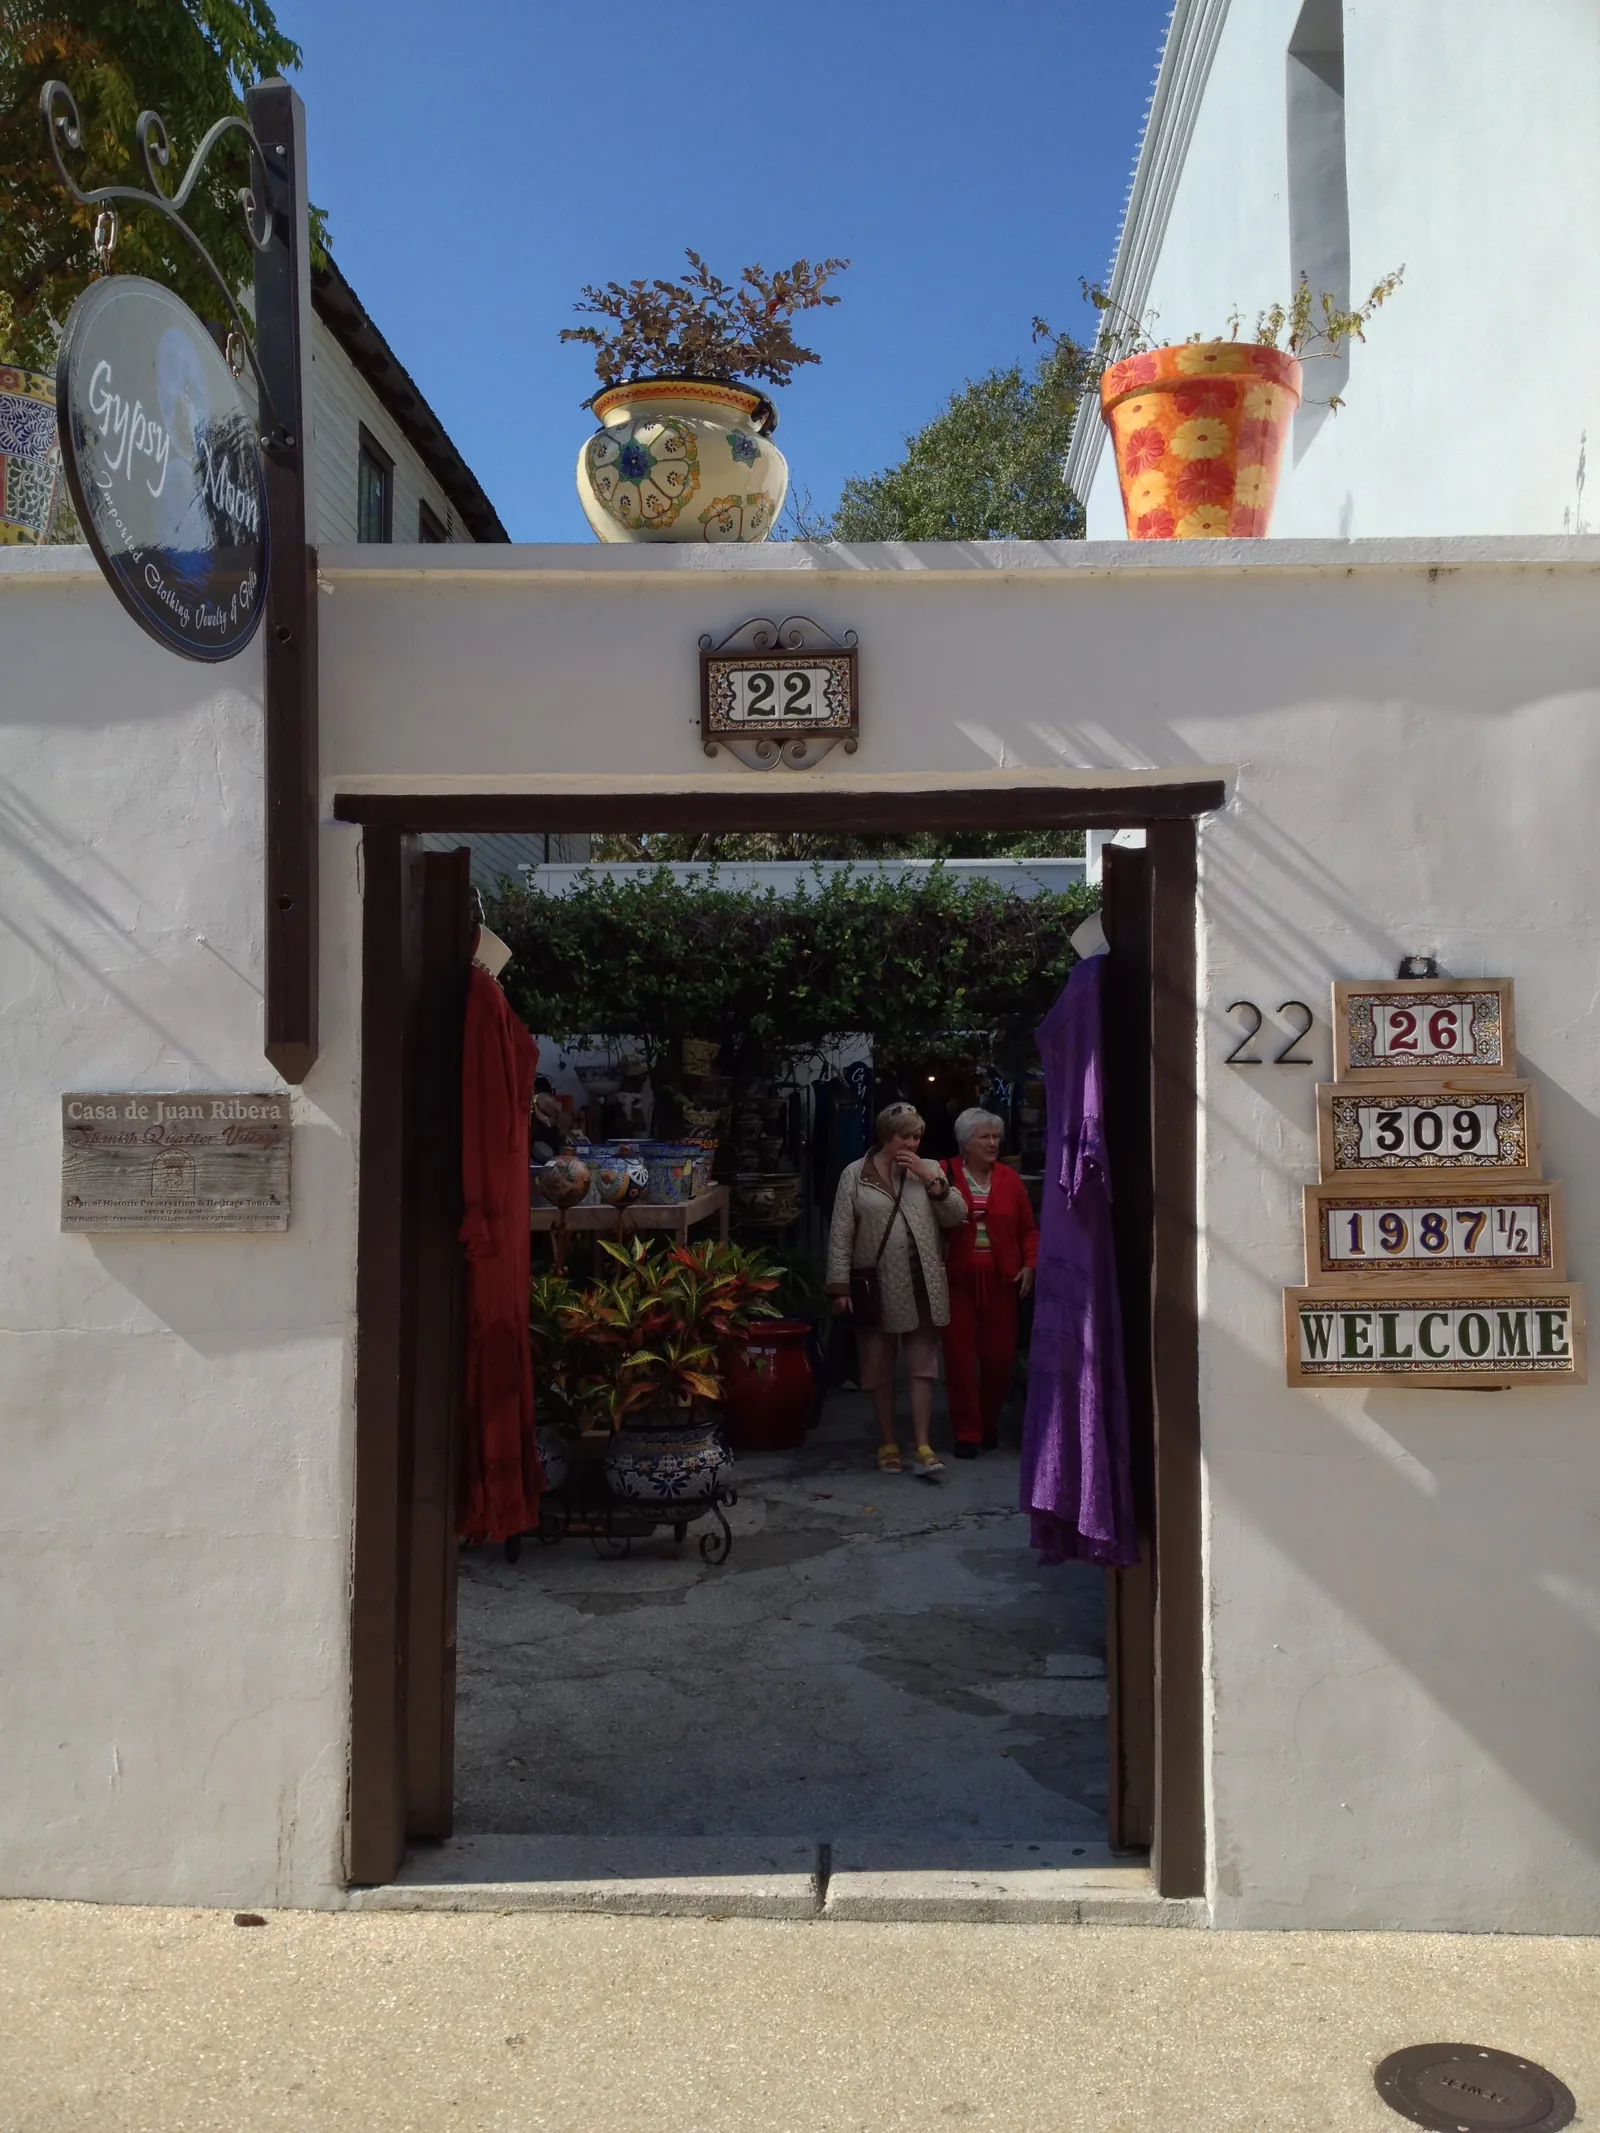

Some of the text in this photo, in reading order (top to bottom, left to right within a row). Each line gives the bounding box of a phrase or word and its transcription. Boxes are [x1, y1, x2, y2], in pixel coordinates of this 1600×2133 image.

[88, 359, 258, 534] Gypsy Moon
[96, 470, 144, 564] Imported
[195, 603, 228, 635] Jewelry
[230, 593, 238, 625] &
[238, 566, 257, 610] Gifts
[747, 671, 813, 717] 22
[1224, 1000, 1314, 1066] 22
[1388, 1009, 1459, 1052] 26
[67, 1099, 282, 1124] Casa de Juan Ribera
[1374, 1110, 1482, 1152] 309
[1299, 1310, 1570, 1361] WELCOME
